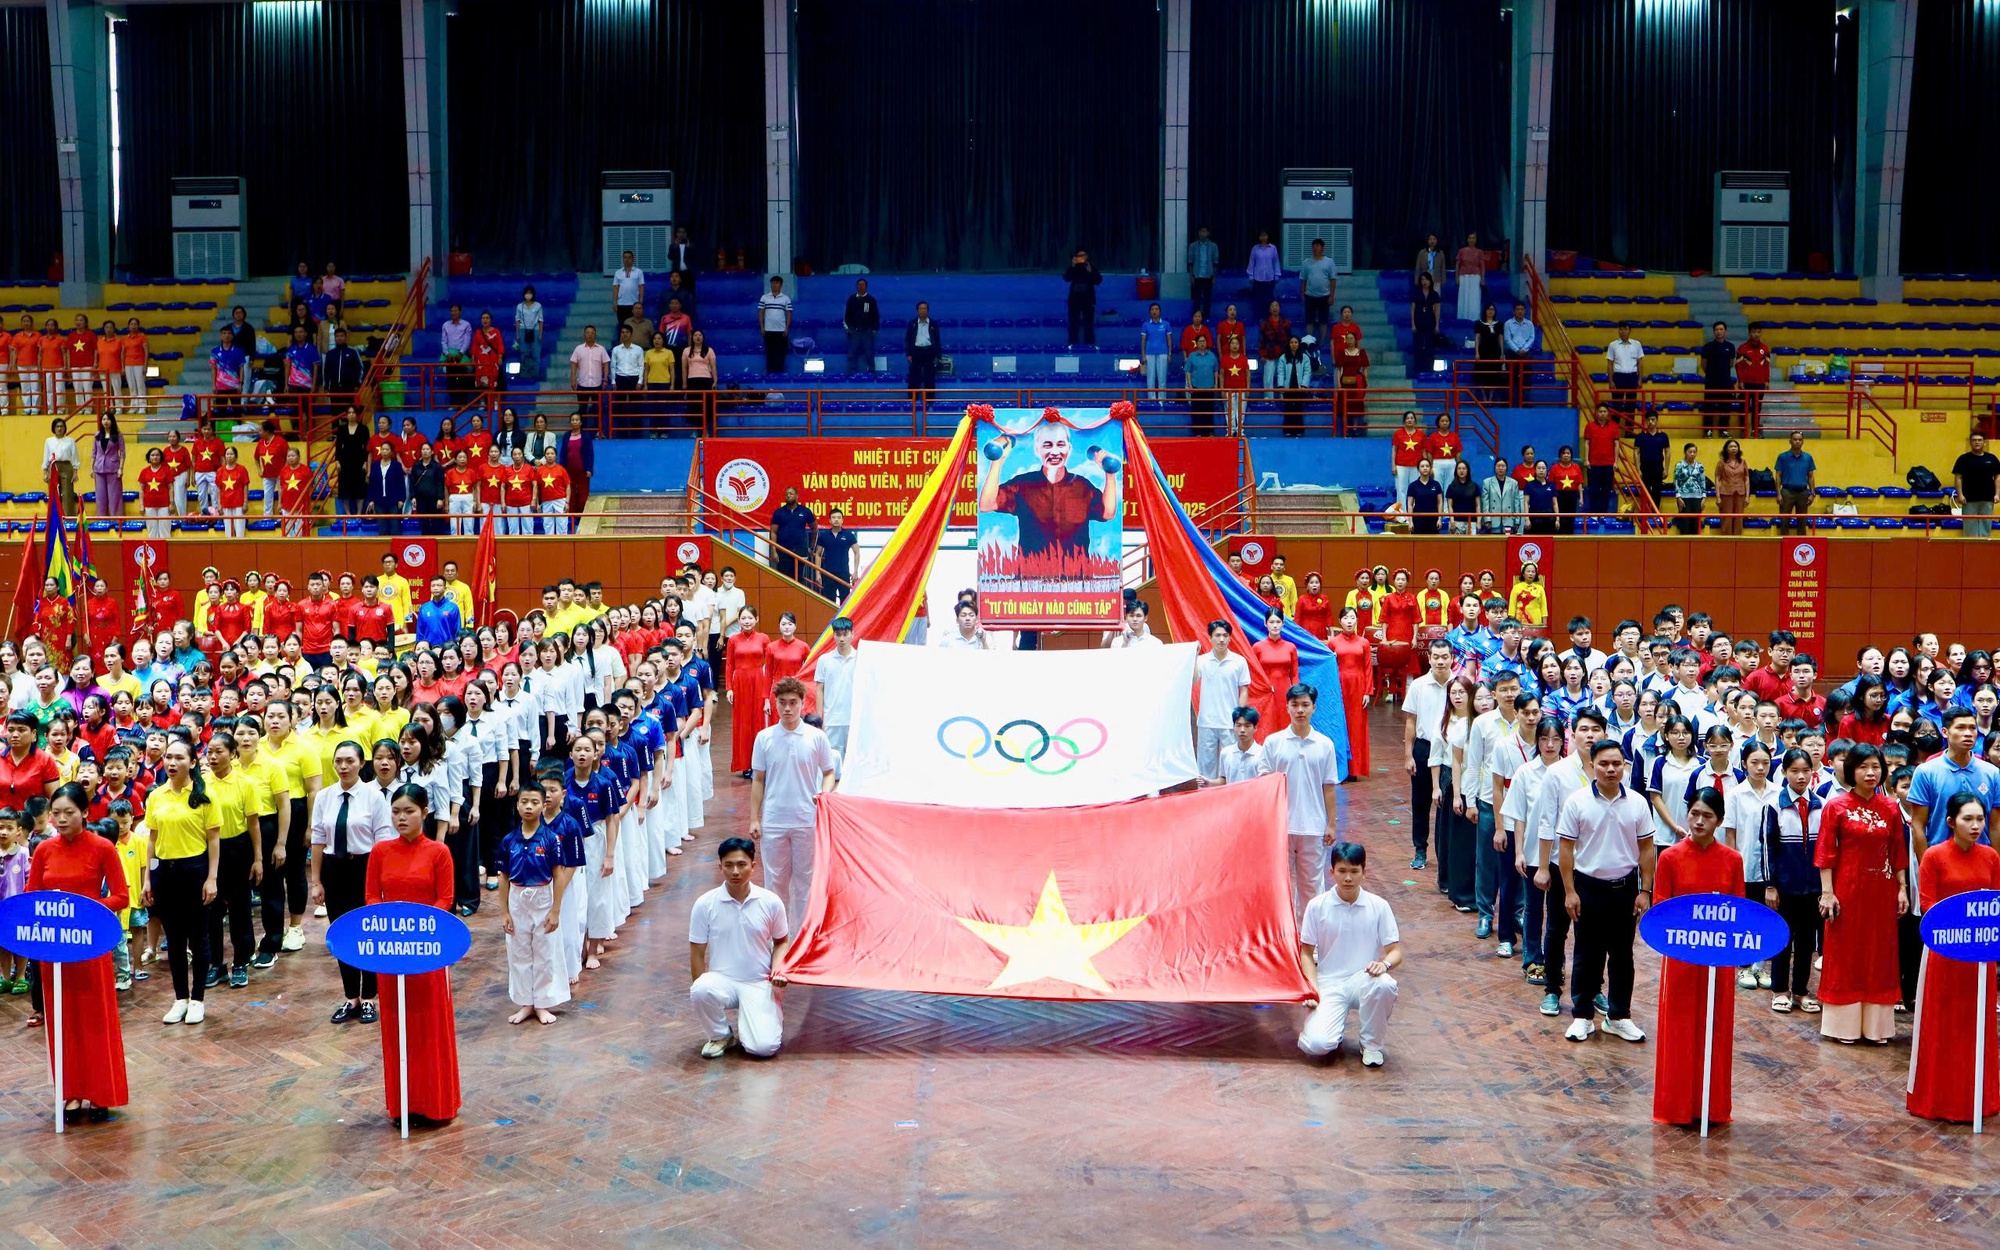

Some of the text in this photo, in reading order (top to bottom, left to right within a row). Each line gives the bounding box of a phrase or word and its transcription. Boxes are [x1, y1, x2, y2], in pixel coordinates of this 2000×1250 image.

[854, 447, 890, 467] NHIỆT
[894, 447, 919, 467] LIỆT
[802, 471, 828, 491] VẬN
[831, 471, 866, 491] ĐỘNG
[870, 472, 902, 490] VIÊN,
[857, 502, 882, 519] DỤC
[1003, 599, 1017, 614] TÔI
[1020, 599, 1043, 614] NGÀY
[1046, 599, 1064, 614] NÀO
[1067, 599, 1092, 614] CŨNG
[35, 897, 75, 918] KHỐI
[1692, 901, 1737, 922] KHỐI
[1966, 896, 2000, 918] KHỐ
[16, 921, 93, 945] MẦM NON
[361, 915, 436, 935] CÂU LẠC BỘ
[1666, 929, 1762, 950] TRỌNG TÀI
[1932, 926, 1999, 946] TRUNG HỌC
[357, 938, 442, 956] VÕ KARATEDO
